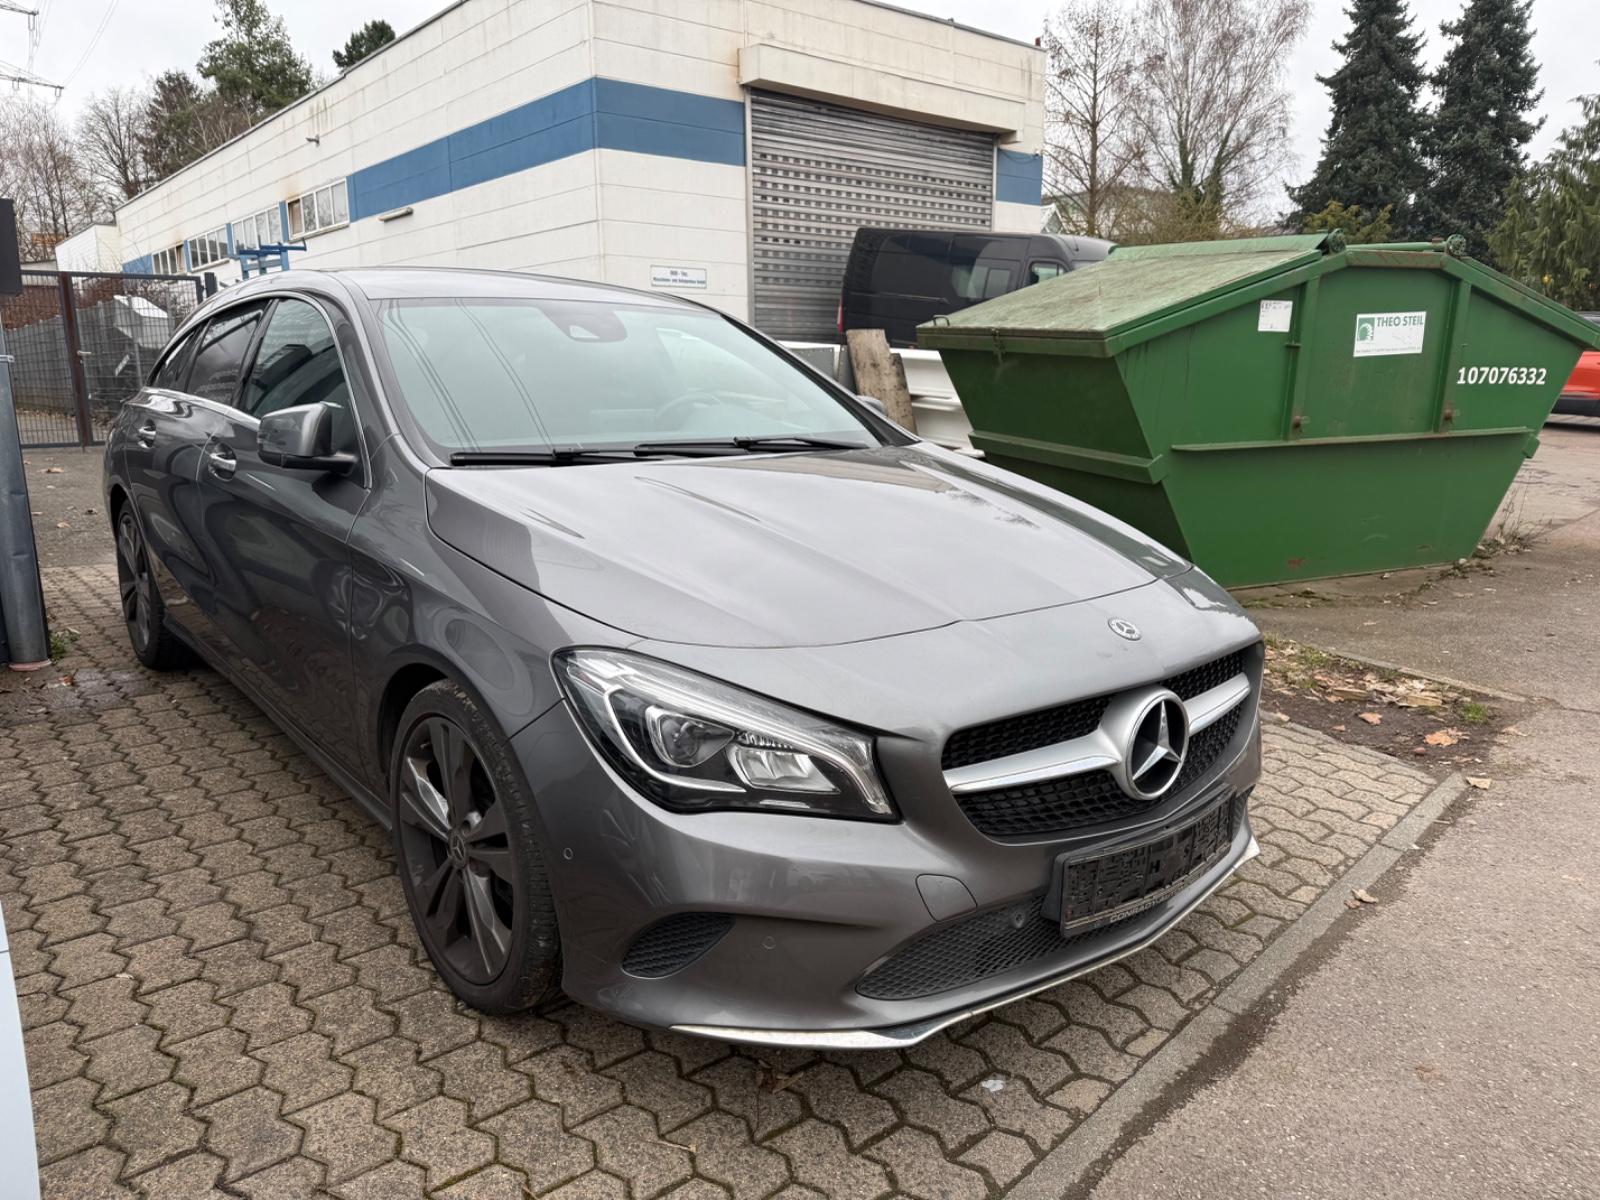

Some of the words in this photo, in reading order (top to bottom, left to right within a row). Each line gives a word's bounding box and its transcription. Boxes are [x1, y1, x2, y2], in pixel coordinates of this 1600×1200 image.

[1377, 316, 1401, 327] THEO
[1403, 315, 1424, 326] STEIL
[1456, 367, 1547, 385] 107076332
